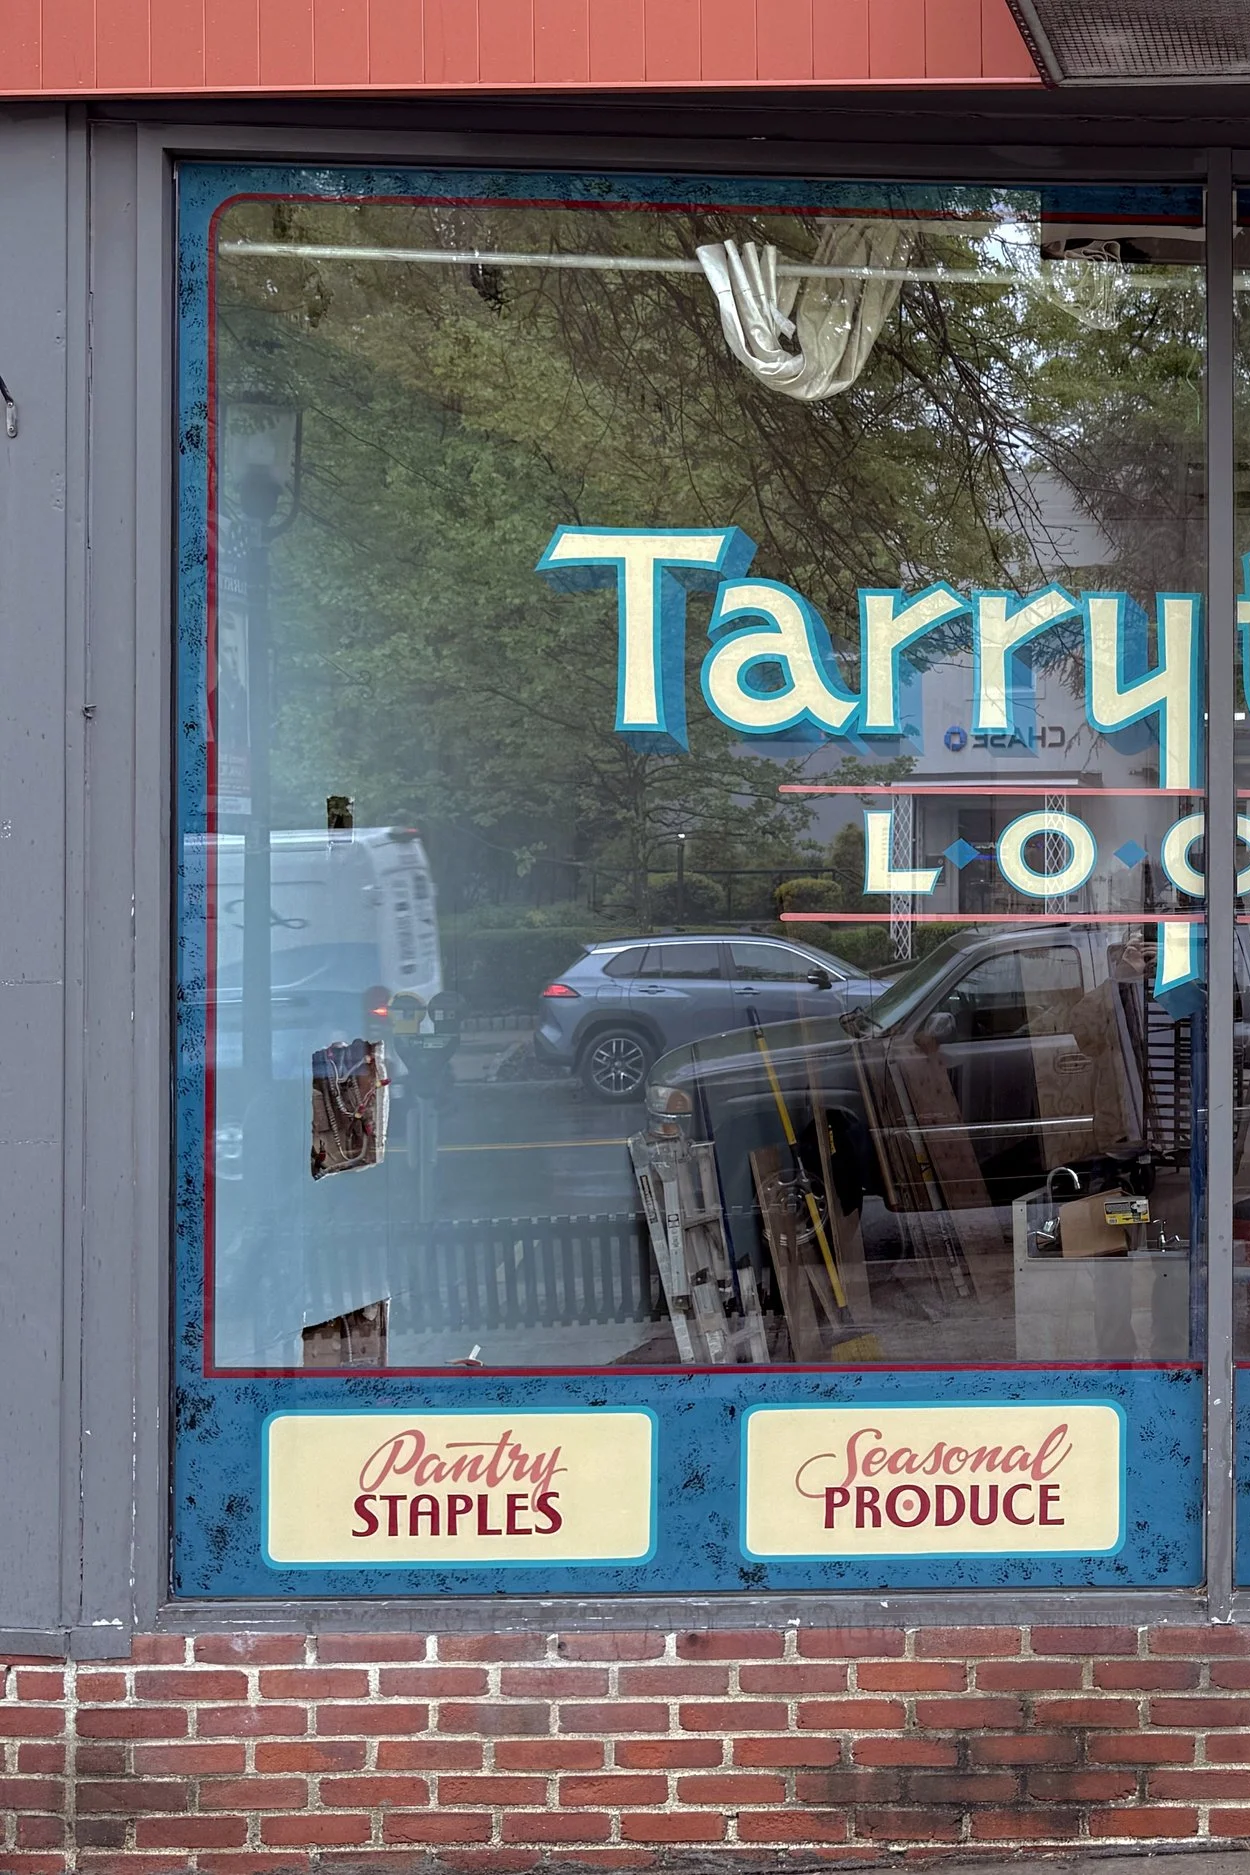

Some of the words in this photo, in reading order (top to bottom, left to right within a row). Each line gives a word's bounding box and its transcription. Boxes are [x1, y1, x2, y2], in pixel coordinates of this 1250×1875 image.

[359, 1428, 568, 1513] Pantry
[796, 1423, 1073, 1499] Seasonal
[351, 1491, 564, 1538] STAPLES
[823, 1483, 1066, 1529] PRODUCE
